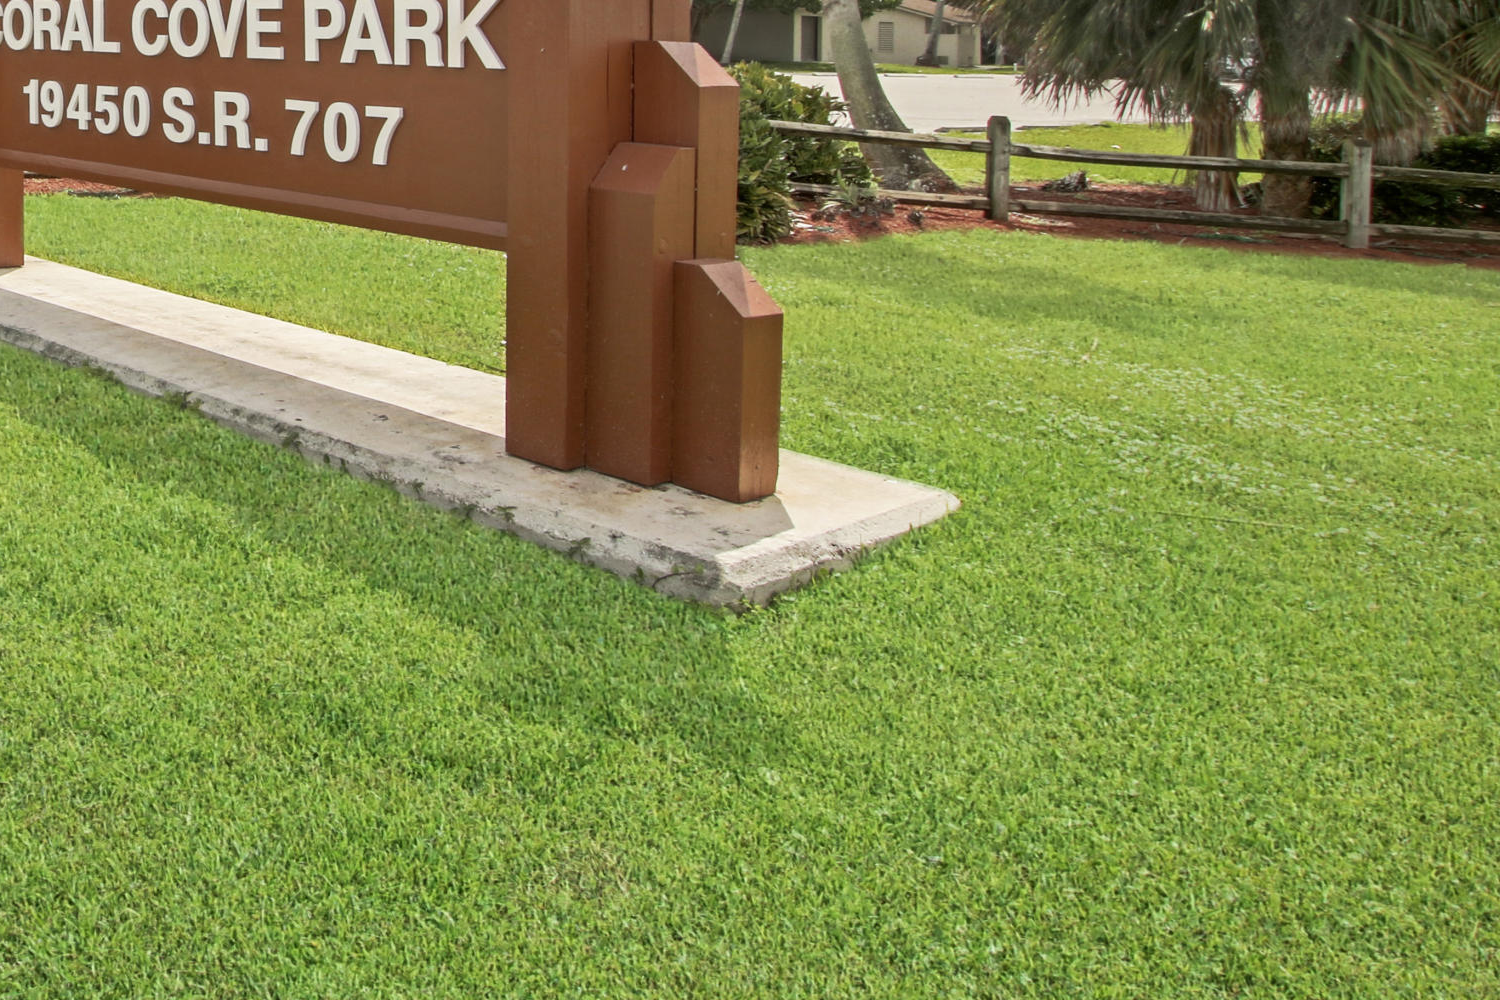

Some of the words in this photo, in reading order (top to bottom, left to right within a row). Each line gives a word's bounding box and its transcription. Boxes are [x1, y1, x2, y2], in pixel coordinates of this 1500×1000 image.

[22, 78, 150, 137] 19450
[162, 86, 269, 152] S.R.
[284, 98, 404, 166] 707
